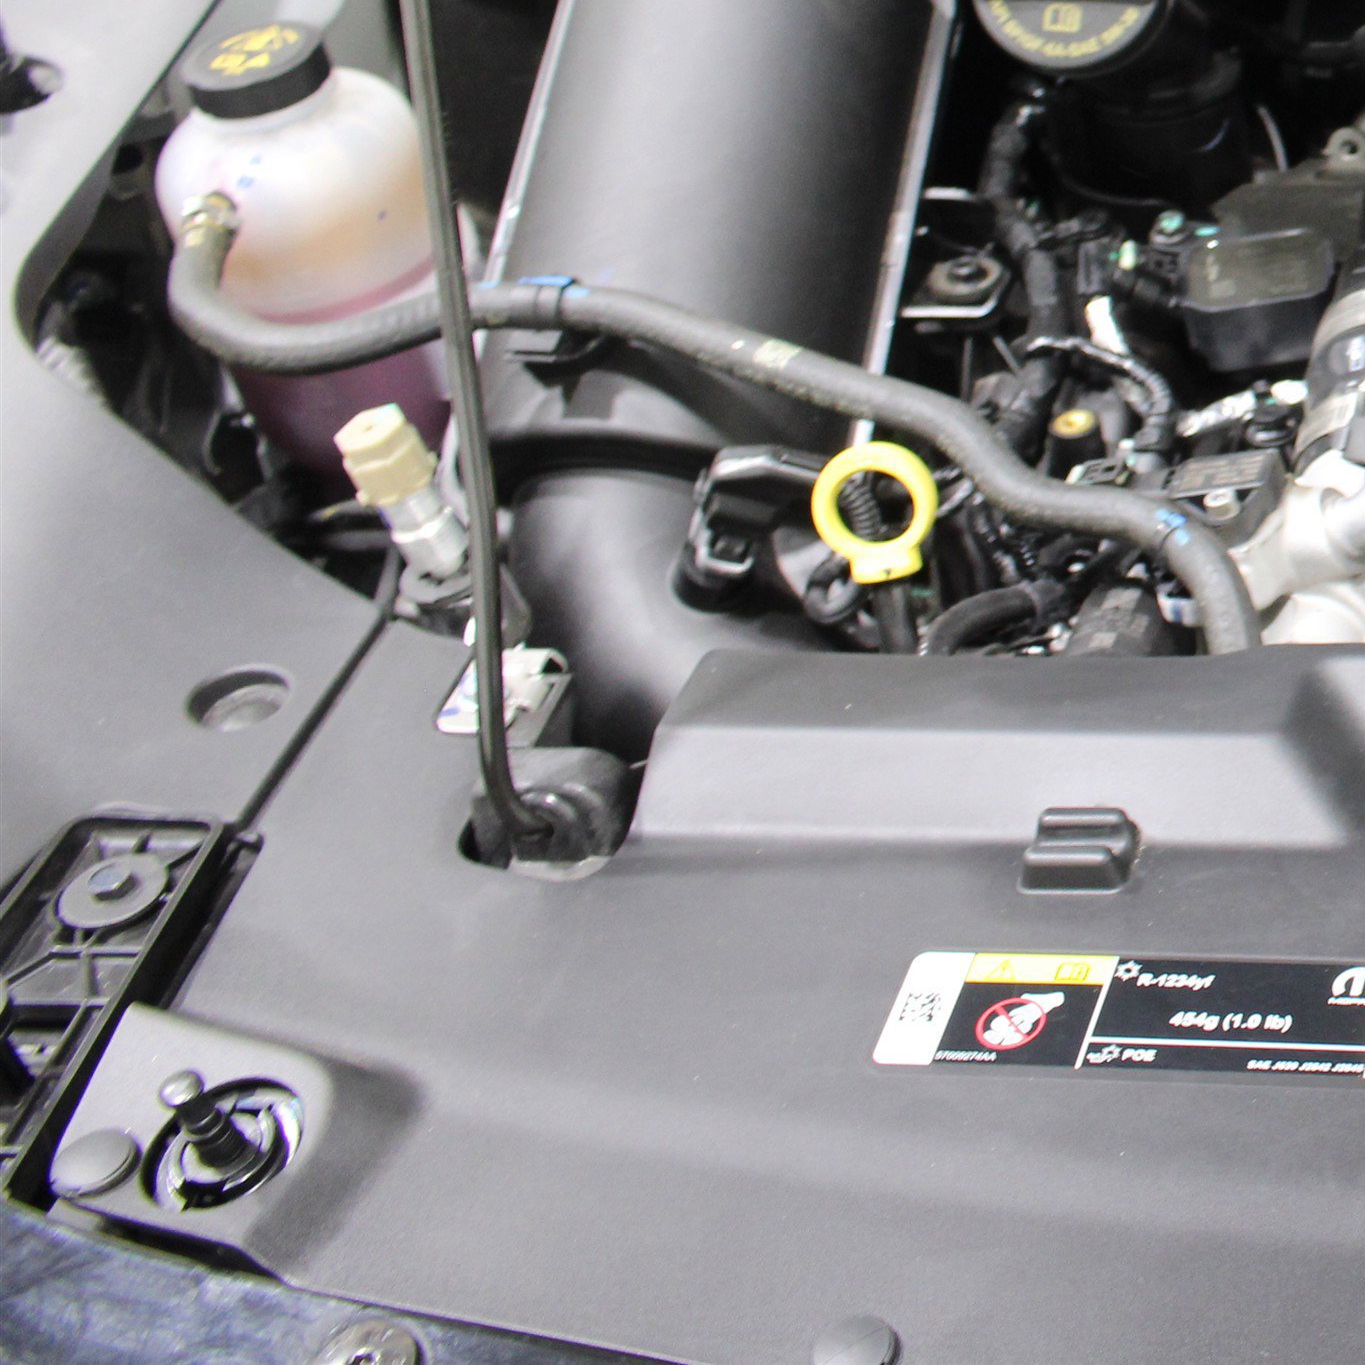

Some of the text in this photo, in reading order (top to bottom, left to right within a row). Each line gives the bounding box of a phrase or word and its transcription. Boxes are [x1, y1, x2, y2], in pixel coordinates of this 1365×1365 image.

[1137, 972, 1215, 991] R-1234yf
[1168, 1010, 1294, 1034] 454g (1.0 lb)
[1121, 1048, 1158, 1063] POE
